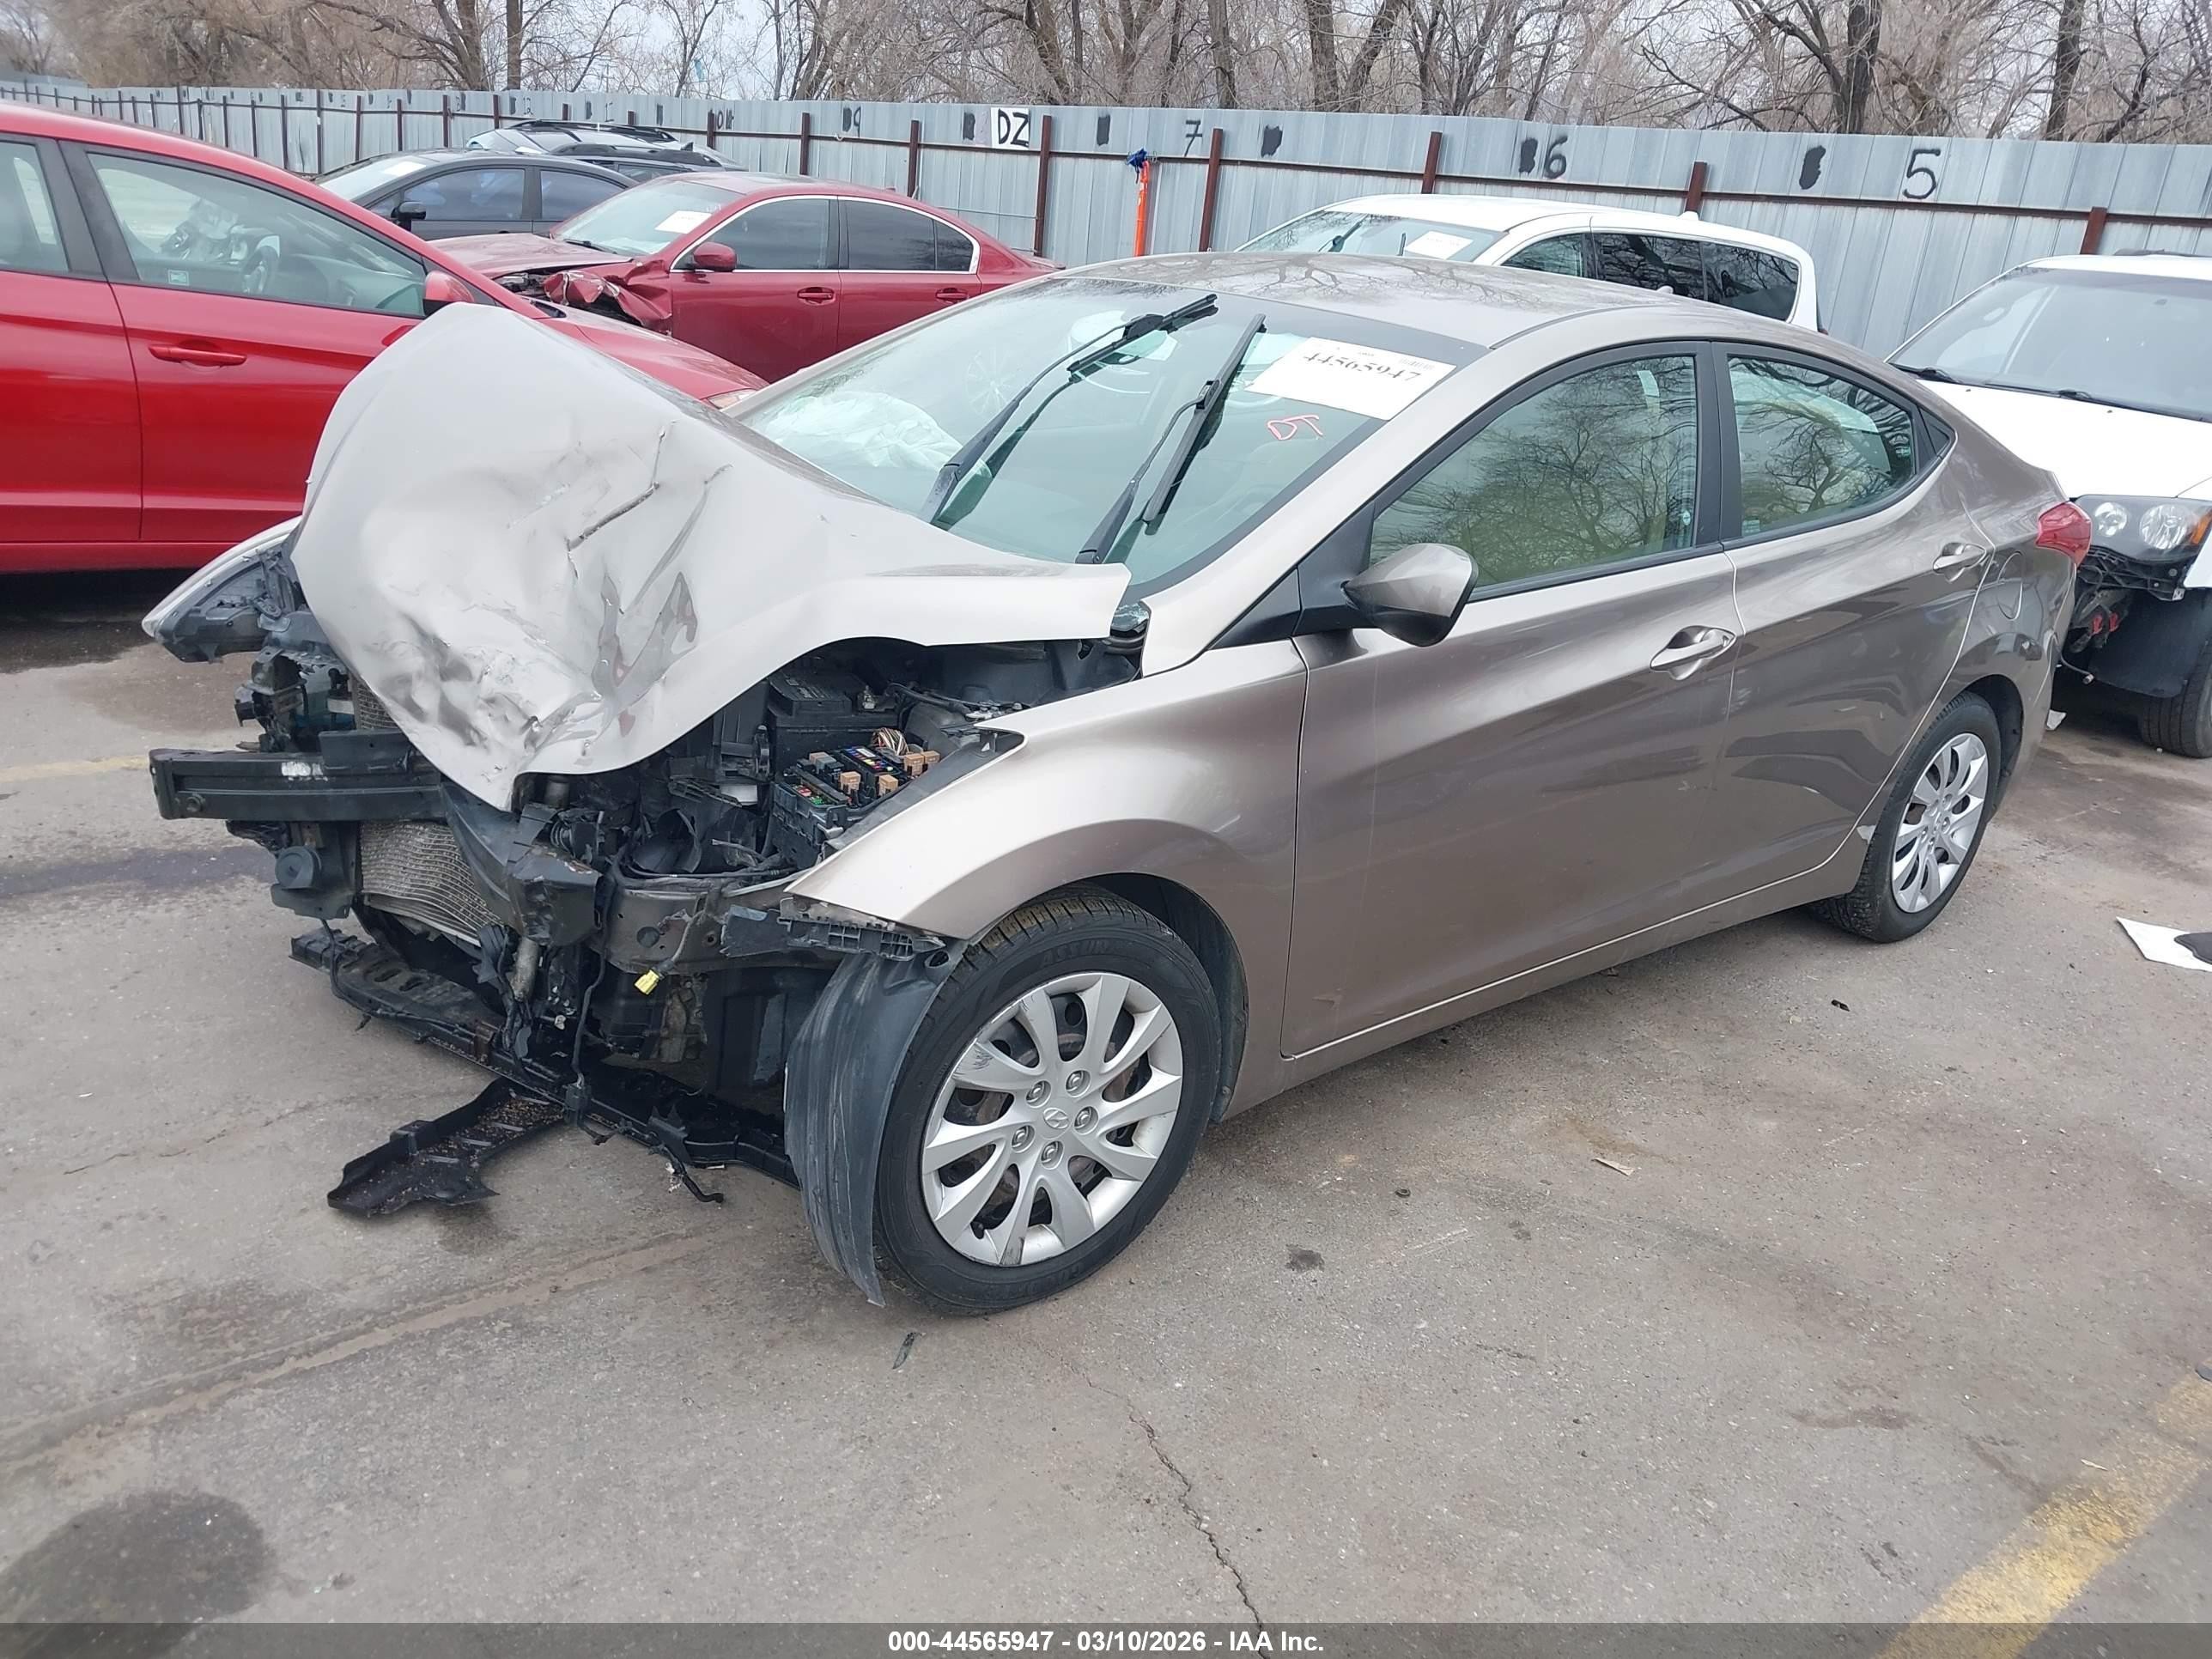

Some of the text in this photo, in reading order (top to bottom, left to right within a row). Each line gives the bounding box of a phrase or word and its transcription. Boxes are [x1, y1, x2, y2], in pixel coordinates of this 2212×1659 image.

[1184, 119, 1202, 156] 7
[1543, 135, 1568, 179] 6
[1902, 148, 1942, 199] 5
